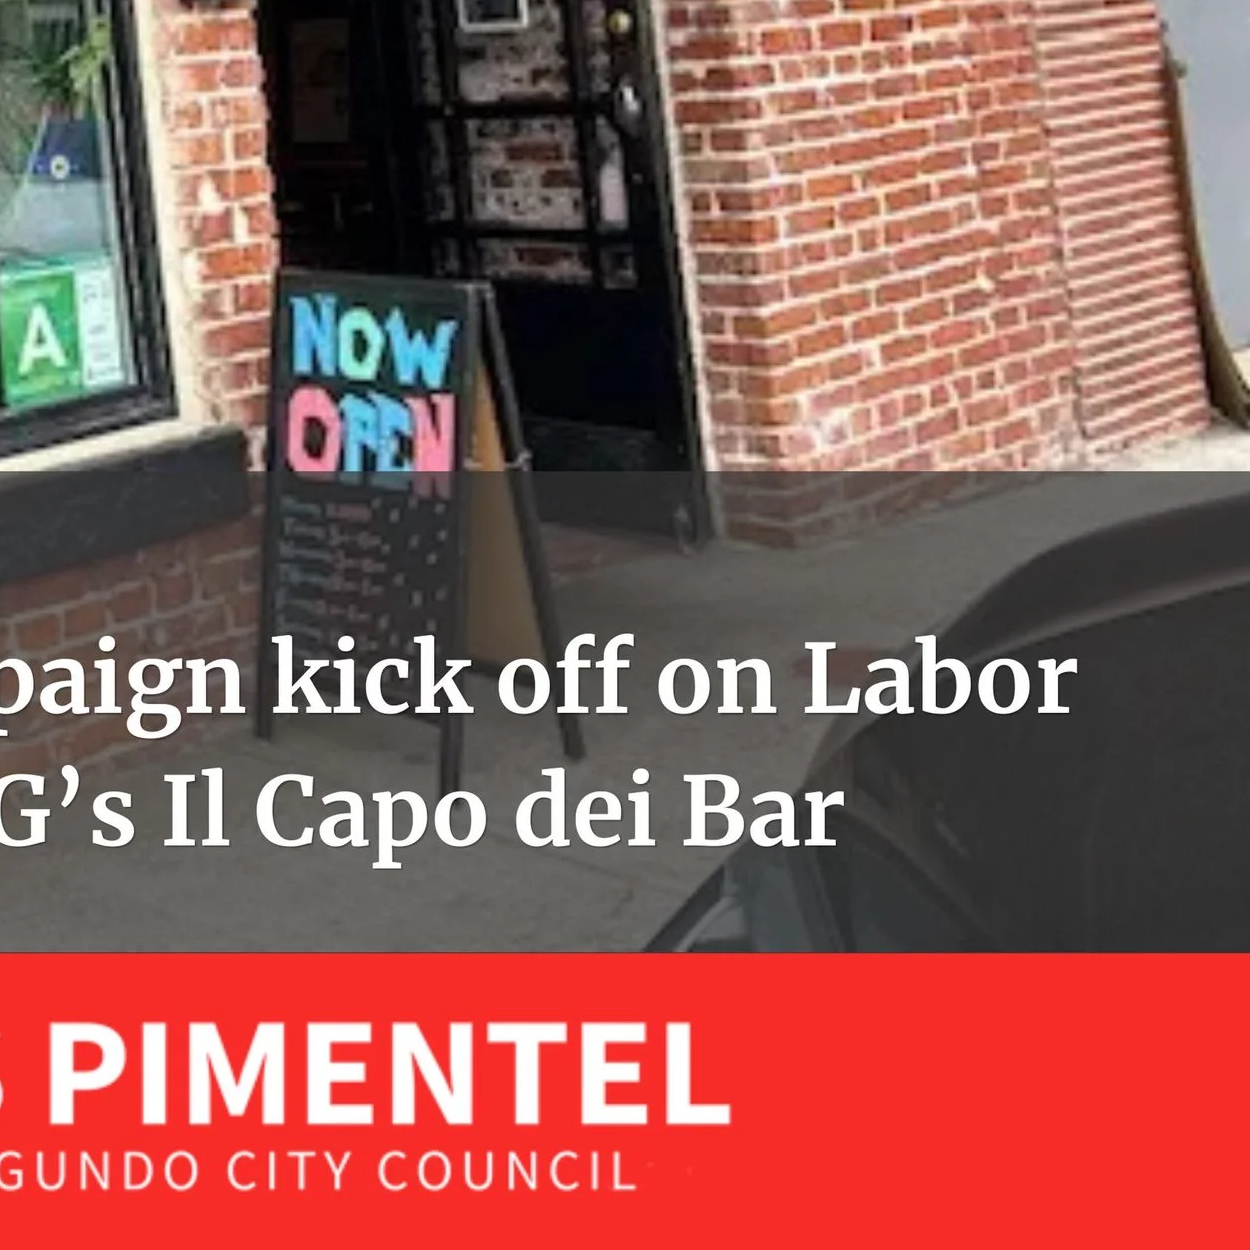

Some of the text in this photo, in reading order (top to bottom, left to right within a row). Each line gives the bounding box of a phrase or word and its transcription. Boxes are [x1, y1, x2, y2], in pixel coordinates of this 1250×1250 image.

[17, 302, 67, 376] A
[290, 292, 458, 389] NOW
[287, 385, 456, 498] OPEN
